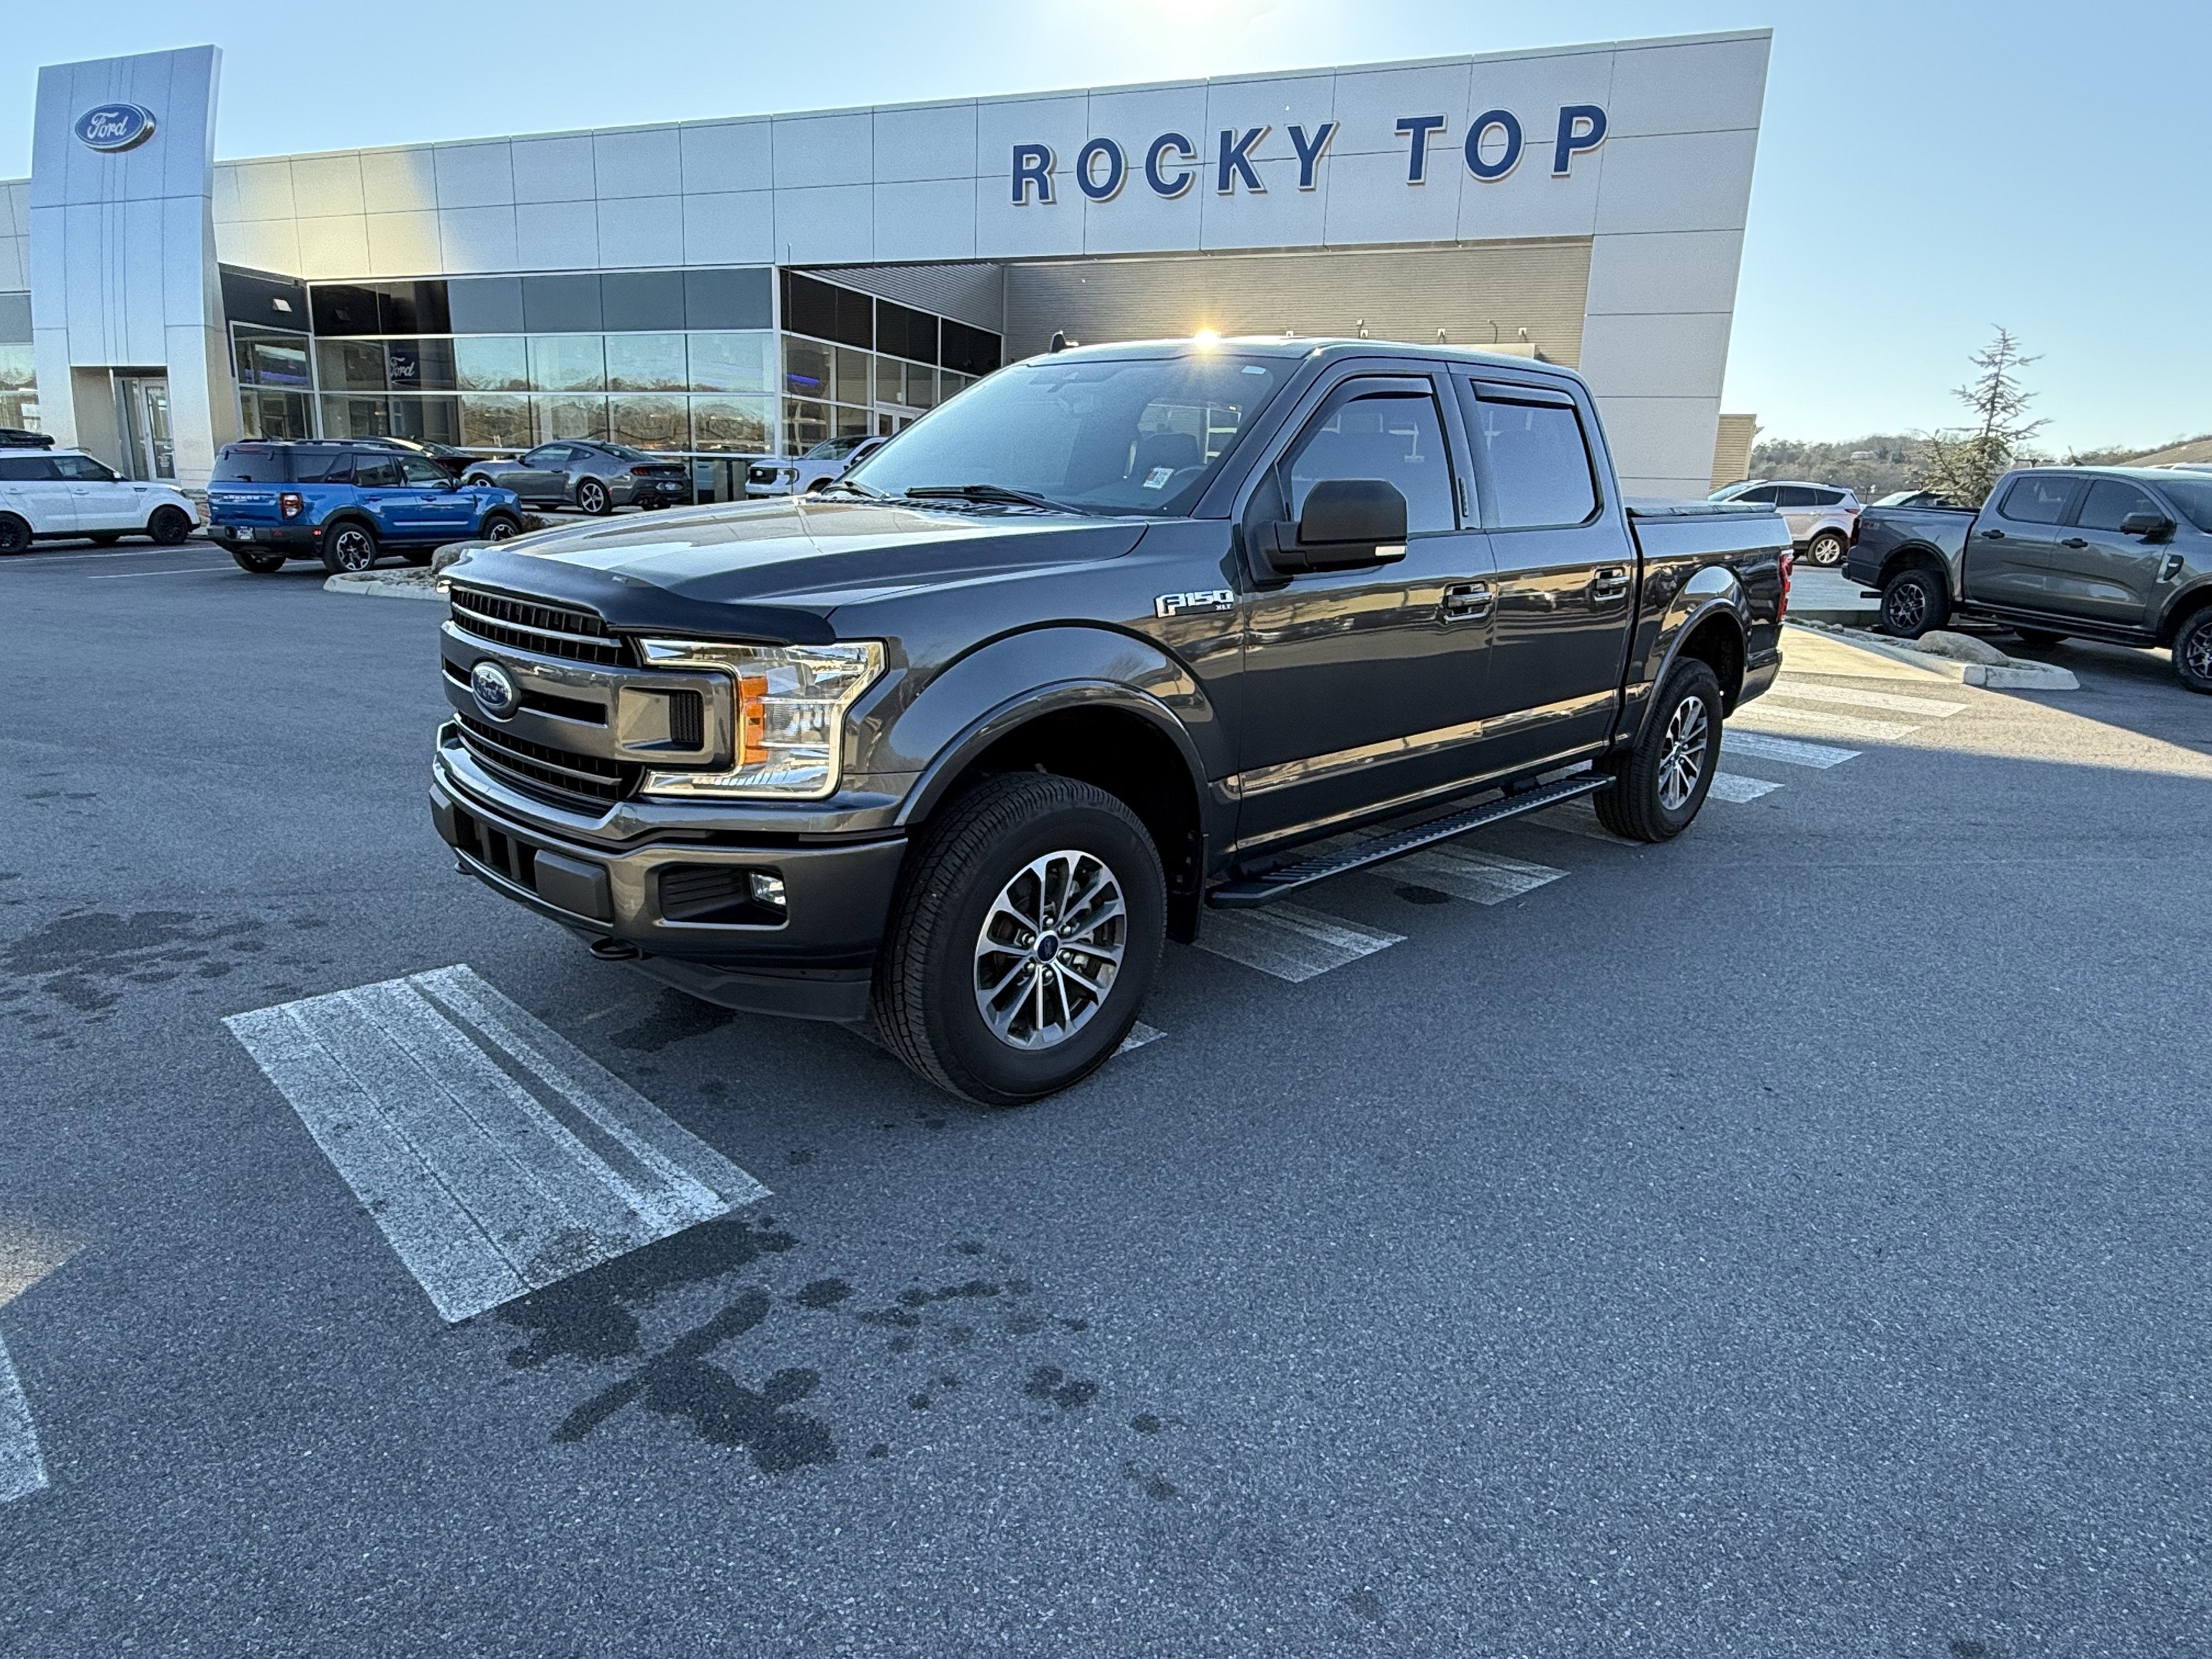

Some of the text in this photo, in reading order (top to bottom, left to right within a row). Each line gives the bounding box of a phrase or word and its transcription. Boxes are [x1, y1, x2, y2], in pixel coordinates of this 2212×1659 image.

[87, 112, 128, 139] Ford
[1011, 102, 1610, 205] ROCKY TOP
[390, 356, 415, 378] Ford
